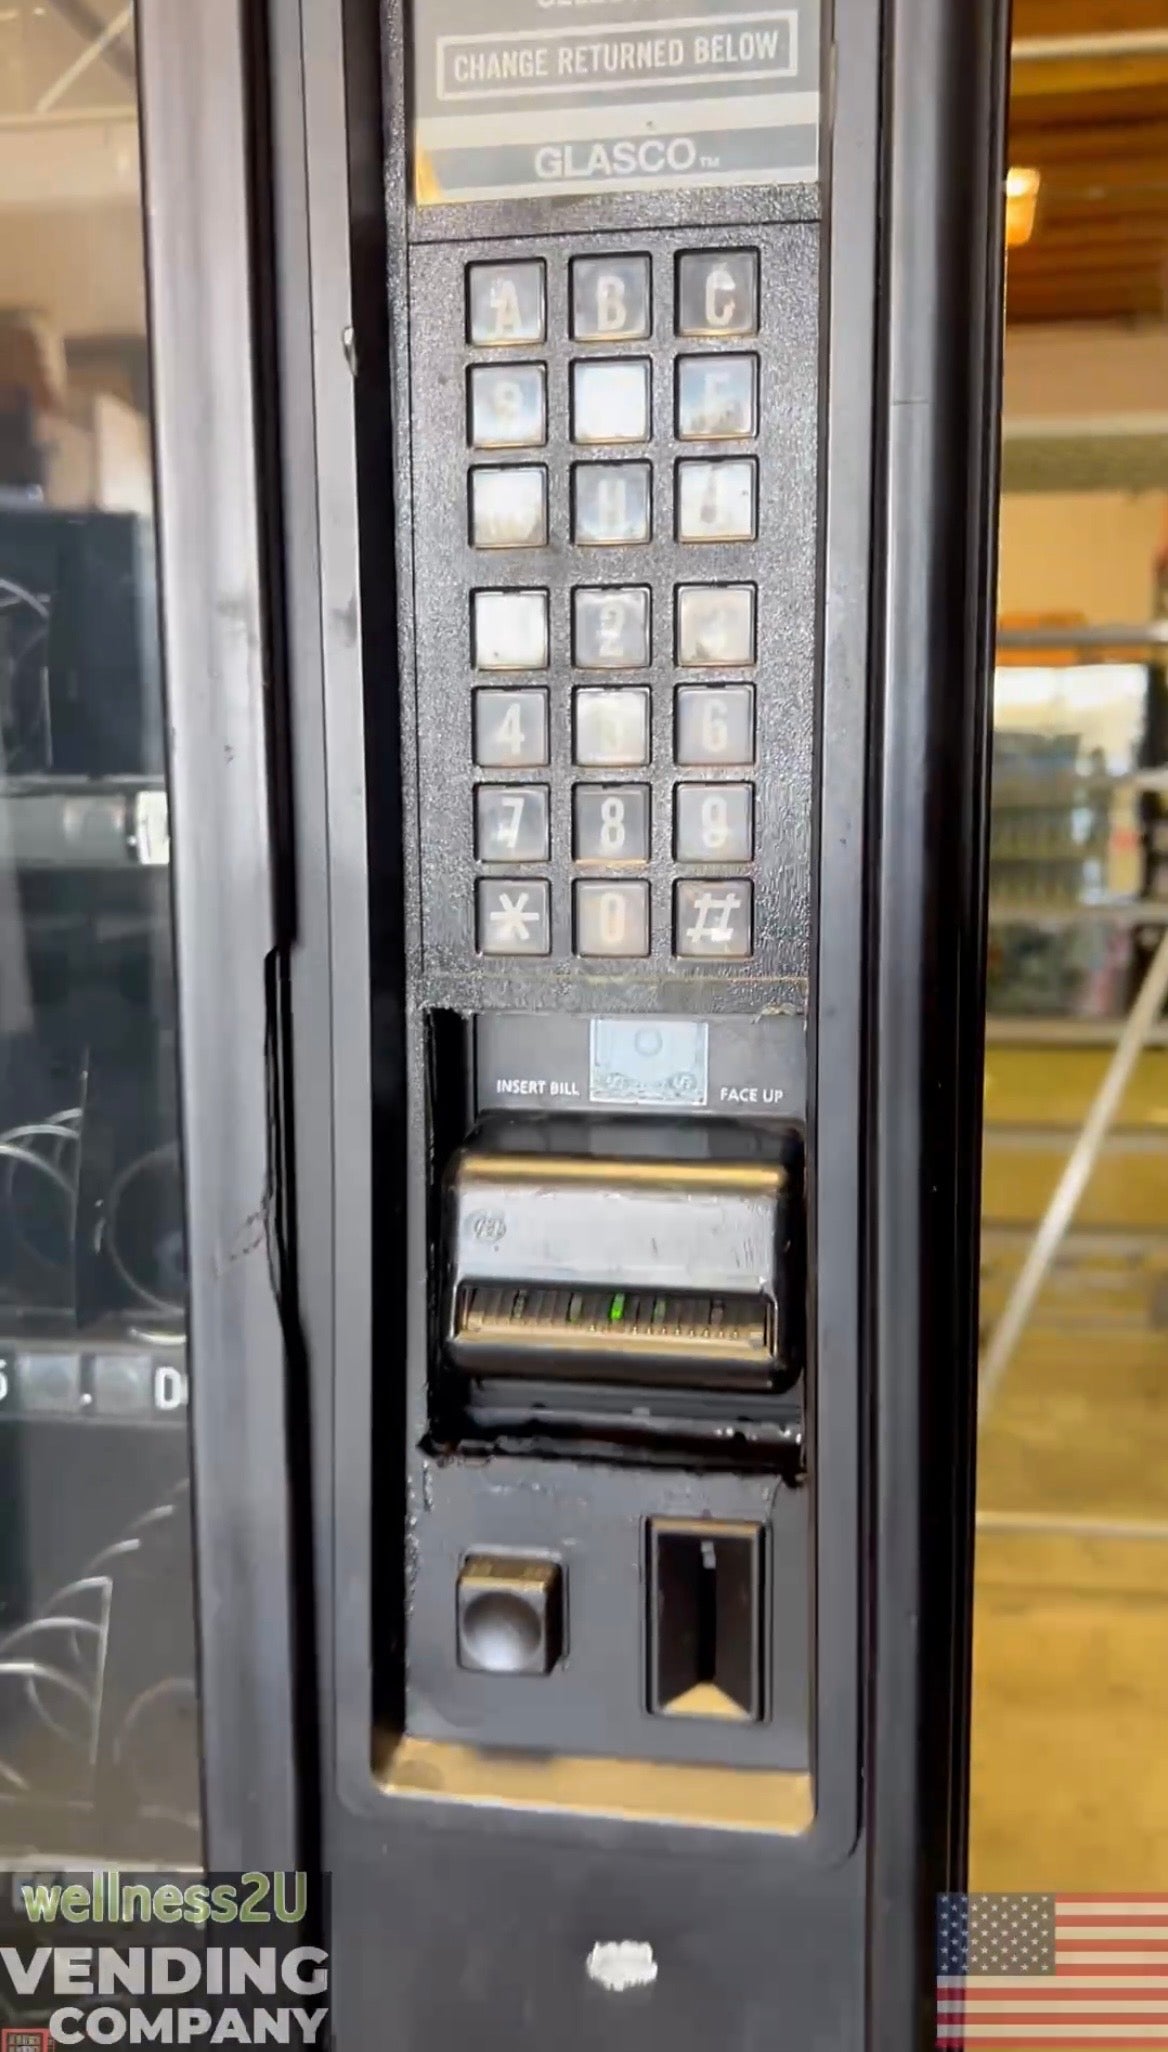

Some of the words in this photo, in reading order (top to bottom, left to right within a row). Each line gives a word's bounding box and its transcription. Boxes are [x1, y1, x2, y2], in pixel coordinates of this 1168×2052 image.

[454, 49, 548, 82] CHANGE
[558, 38, 684, 75] RETURNED
[694, 31, 778, 64] BELOW
[534, 138, 696, 179] GLASCO
[700, 156, 720, 168] TM
[597, 275, 627, 331] B
[496, 703, 525, 756] 4
[702, 698, 728, 752] 6
[498, 797, 525, 848] 7
[600, 797, 626, 850] 8
[701, 796, 729, 848] 9
[496, 1079, 546, 1095] INSERT
[550, 1080, 580, 1096] BILL
[720, 1087, 758, 1103] FACE
[763, 1088, 784, 1103] UP
